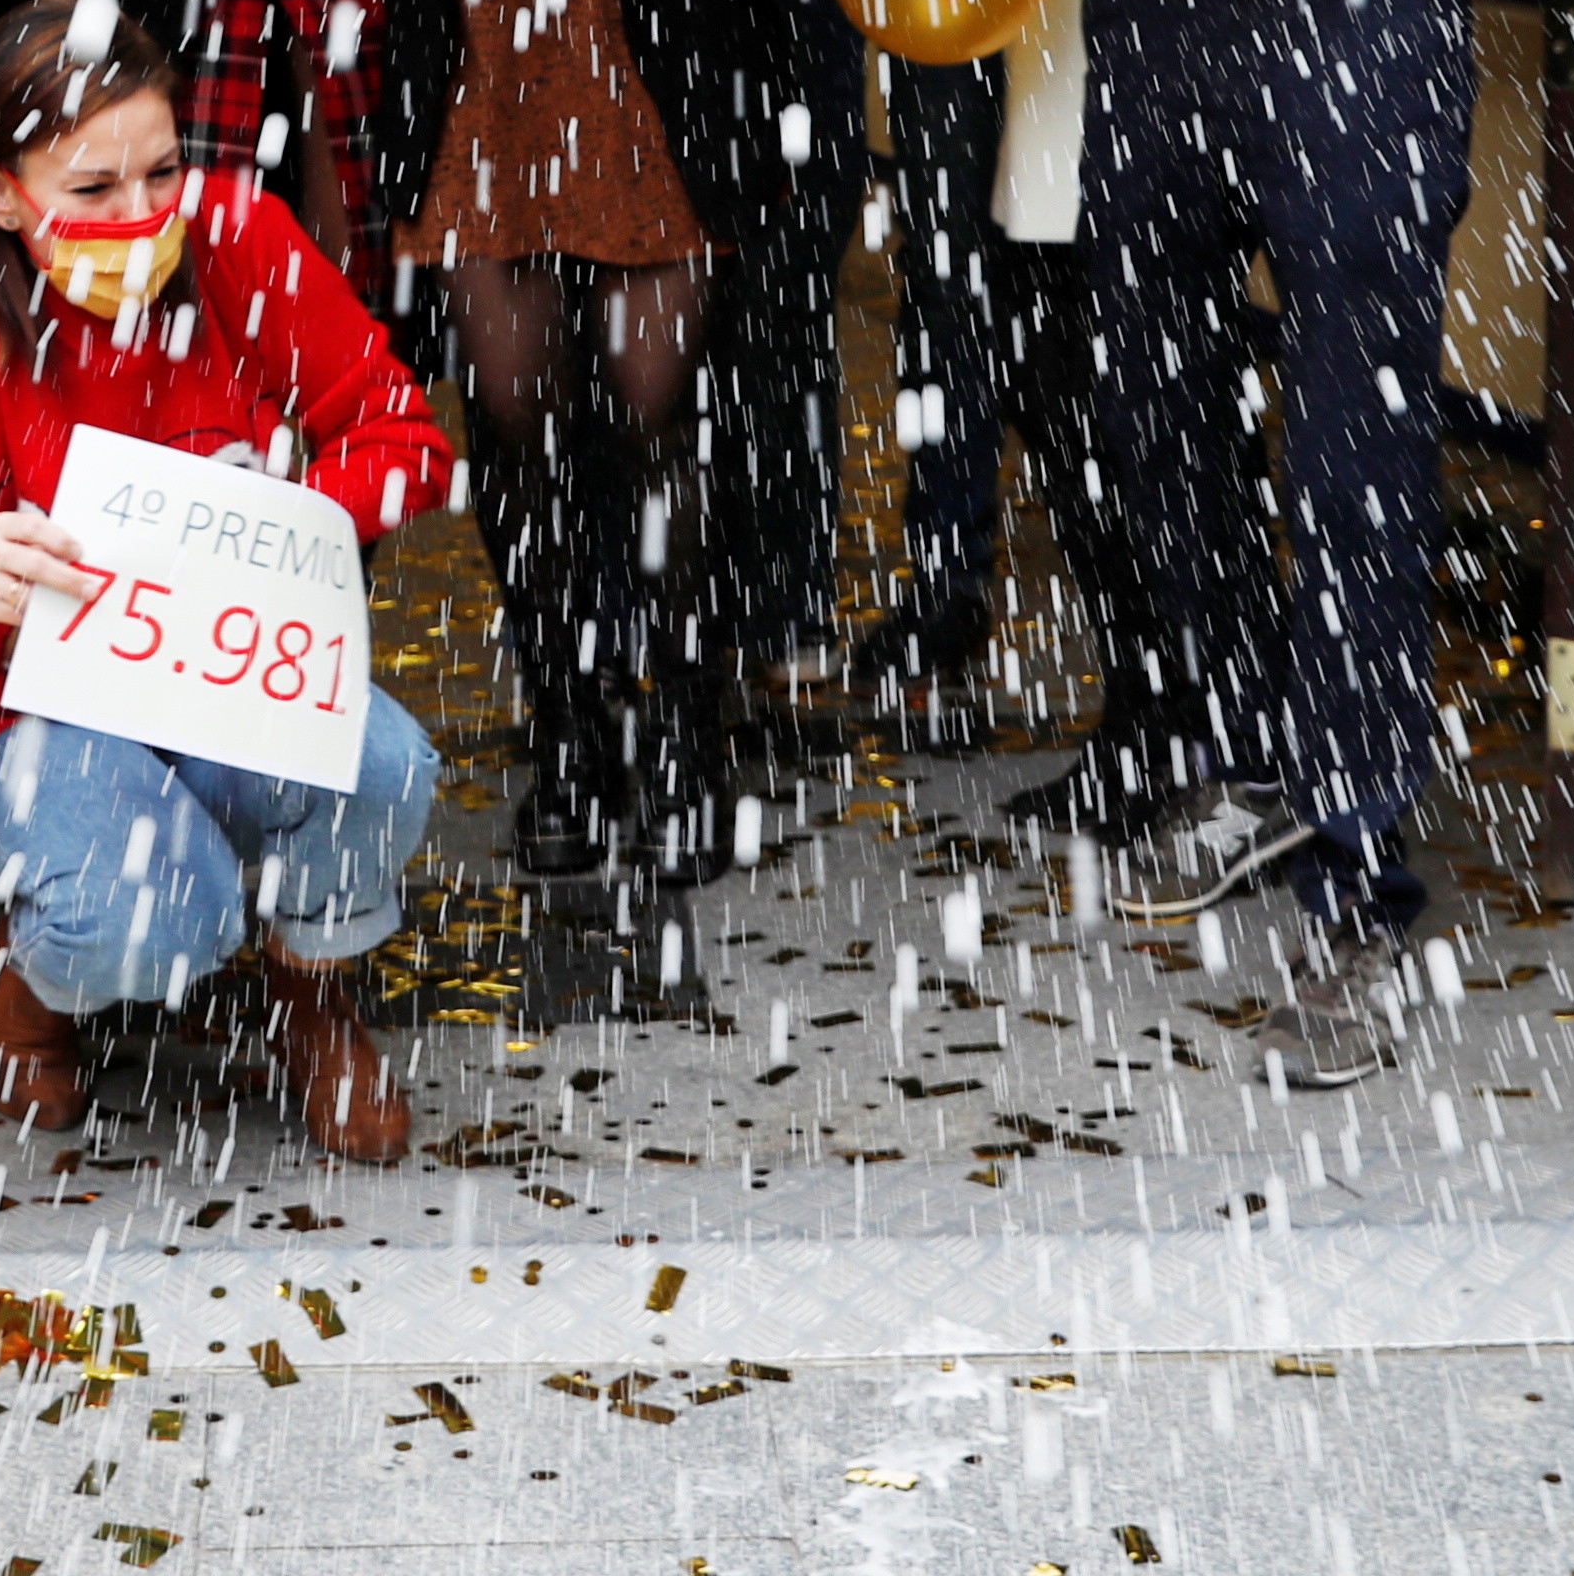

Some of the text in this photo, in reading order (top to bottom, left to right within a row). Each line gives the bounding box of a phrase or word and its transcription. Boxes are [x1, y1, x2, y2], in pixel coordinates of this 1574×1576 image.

[101, 482, 350, 592] 4º PREMIO
[56, 559, 348, 716] 75.981
